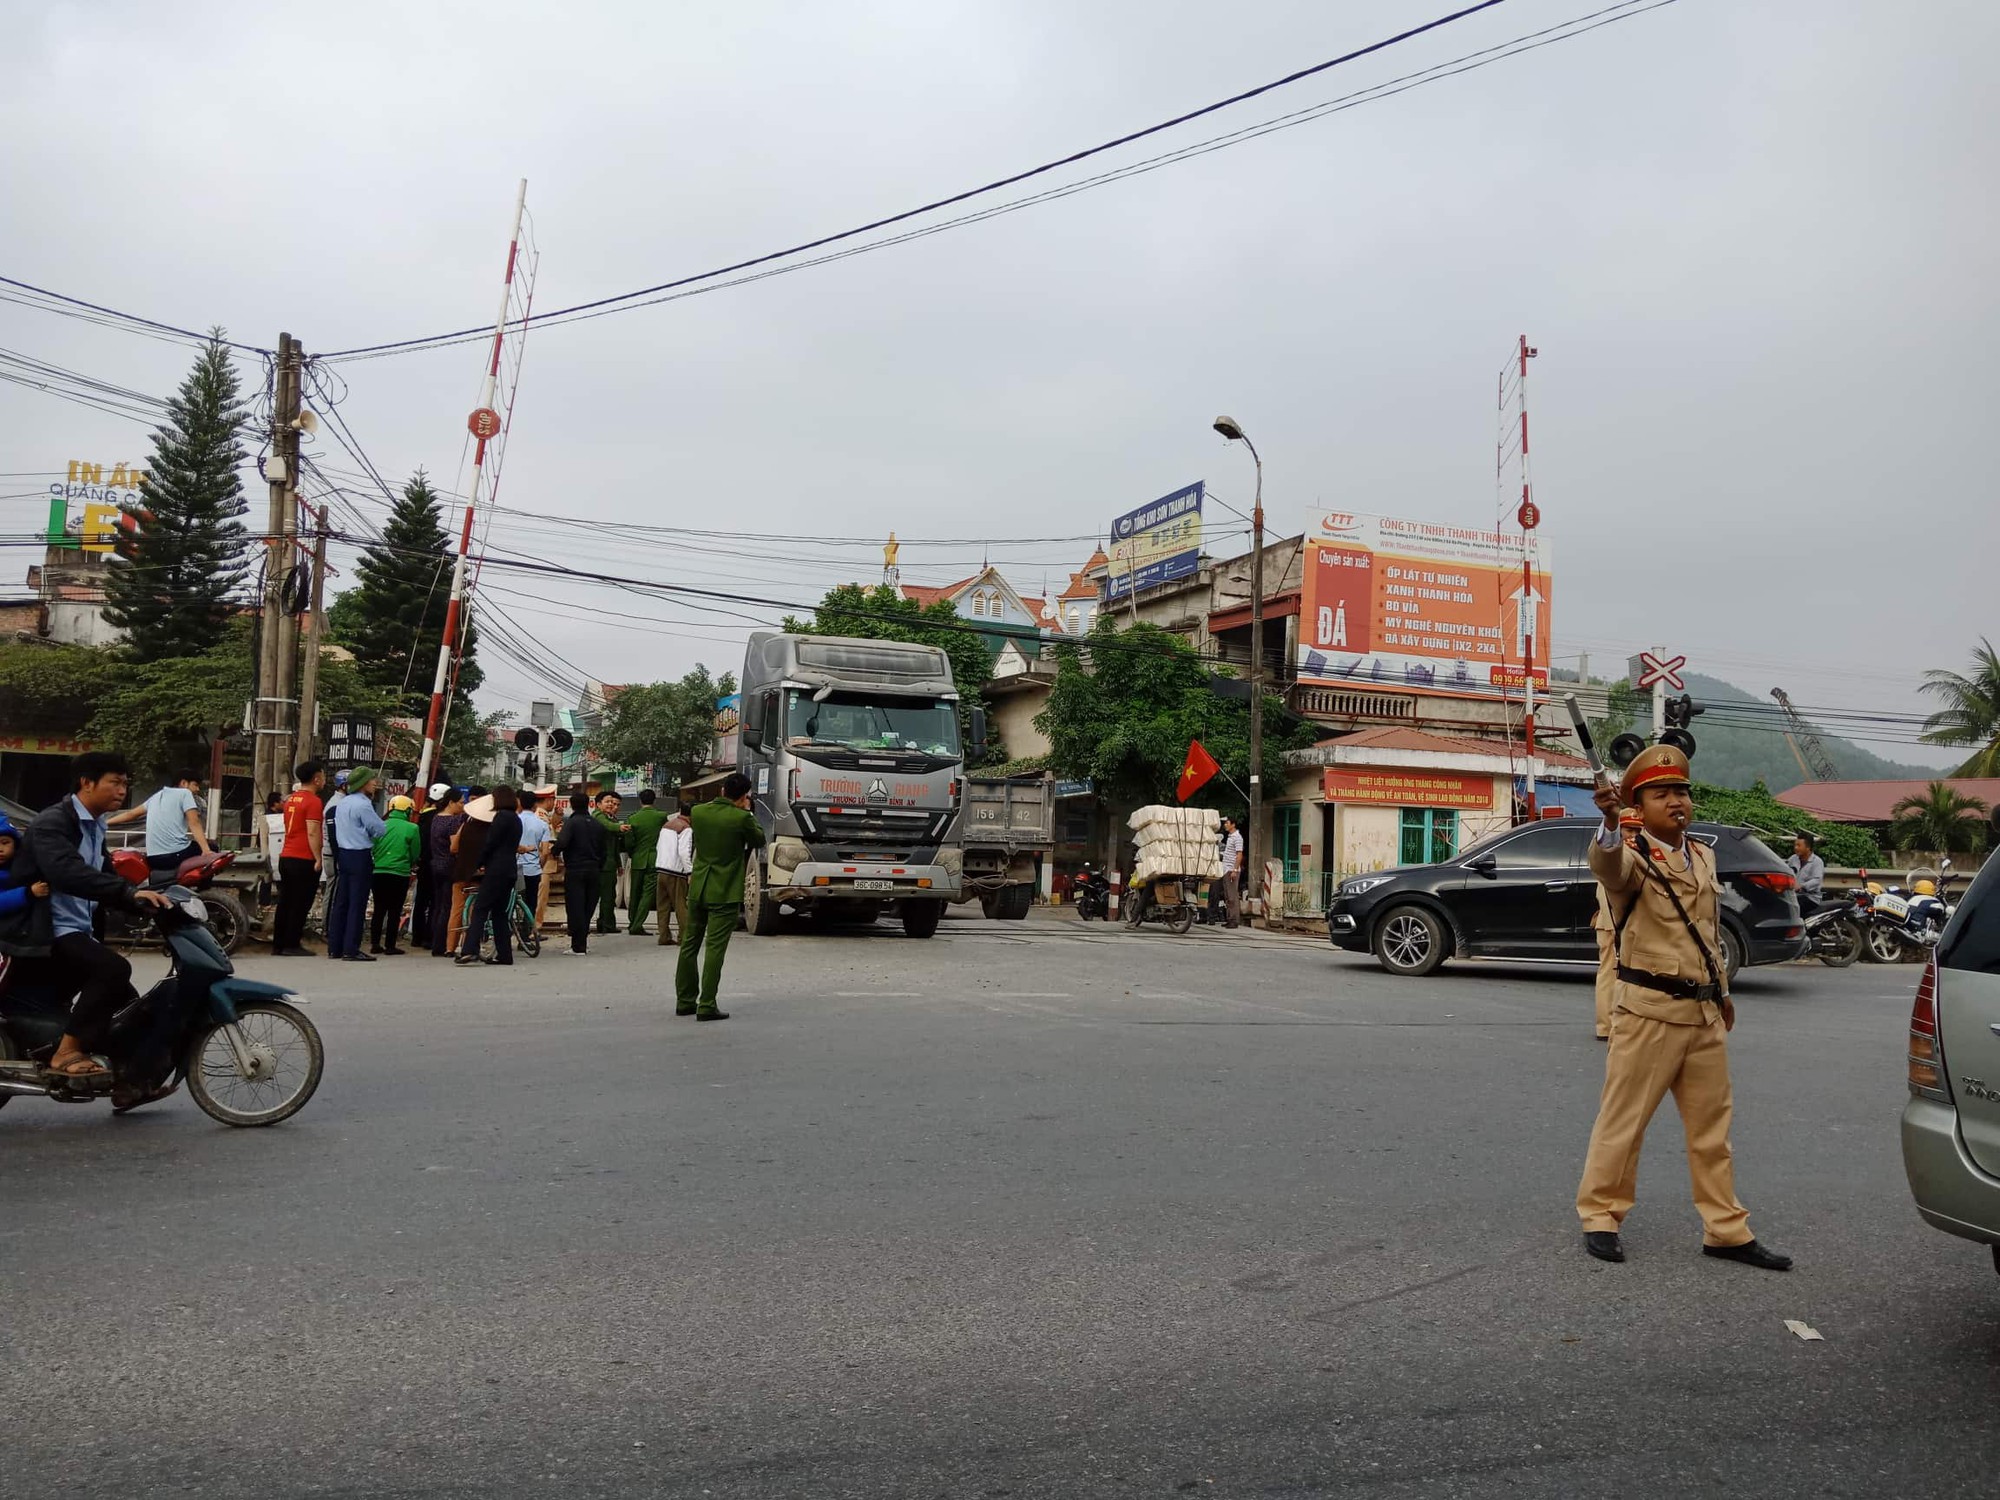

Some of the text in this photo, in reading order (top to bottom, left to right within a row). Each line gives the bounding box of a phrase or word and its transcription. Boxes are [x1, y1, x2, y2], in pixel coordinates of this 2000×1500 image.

[68, 459, 102, 485] IN
[1331, 513, 1354, 525] TTT
[1379, 517, 1404, 531] CÔNG
[1406, 522, 1419, 532] TY
[1420, 525, 1445, 536] TNHH
[1447, 528, 1478, 540] THANH
[1481, 531, 1511, 545] THANH
[1319, 549, 1341, 568] Chuyên
[1342, 552, 1353, 567] sản
[1387, 564, 1401, 579] ỐP
[1422, 571, 1435, 586] TỰ
[1437, 573, 1468, 587] NHIÊN
[1386, 584, 1415, 598] XANH
[1417, 587, 1451, 601] THANH
[1317, 599, 1347, 647] ĐÁ
[1404, 619, 1432, 634] NGHỆ
[1434, 620, 1476, 637] NGUYÊN
[1400, 634, 1421, 647] XÂY
[1422, 637, 1450, 651] DỰNG
[1506, 667, 1526, 677] Hotlin
[331, 720, 348, 740] NHÀ
[355, 722, 373, 741] NHÀ
[820, 776, 862, 795] TRƯỜNG
[1357, 776, 1373, 787] NHIỆT
[1374, 776, 1385, 787] LIỆT
[1415, 778, 1432, 789] THÁNG
[1433, 779, 1447, 789] CÔNG
[1447, 780, 1462, 790] NHÂN
[1330, 786, 1337, 797] VÀ
[1337, 787, 1355, 798] THÁNG
[1356, 787, 1370, 798] HÀNH
[1370, 789, 1386, 801] ĐỘNG
[1386, 788, 1394, 799] VỀ
[1394, 791, 1402, 799] AN
[1418, 791, 1425, 803] VỆ
[1425, 792, 1438, 802] SINH
[1439, 793, 1449, 803] LAO
[1449, 793, 1463, 804] ĐỘNG
[1464, 794, 1476, 804] NĂM
